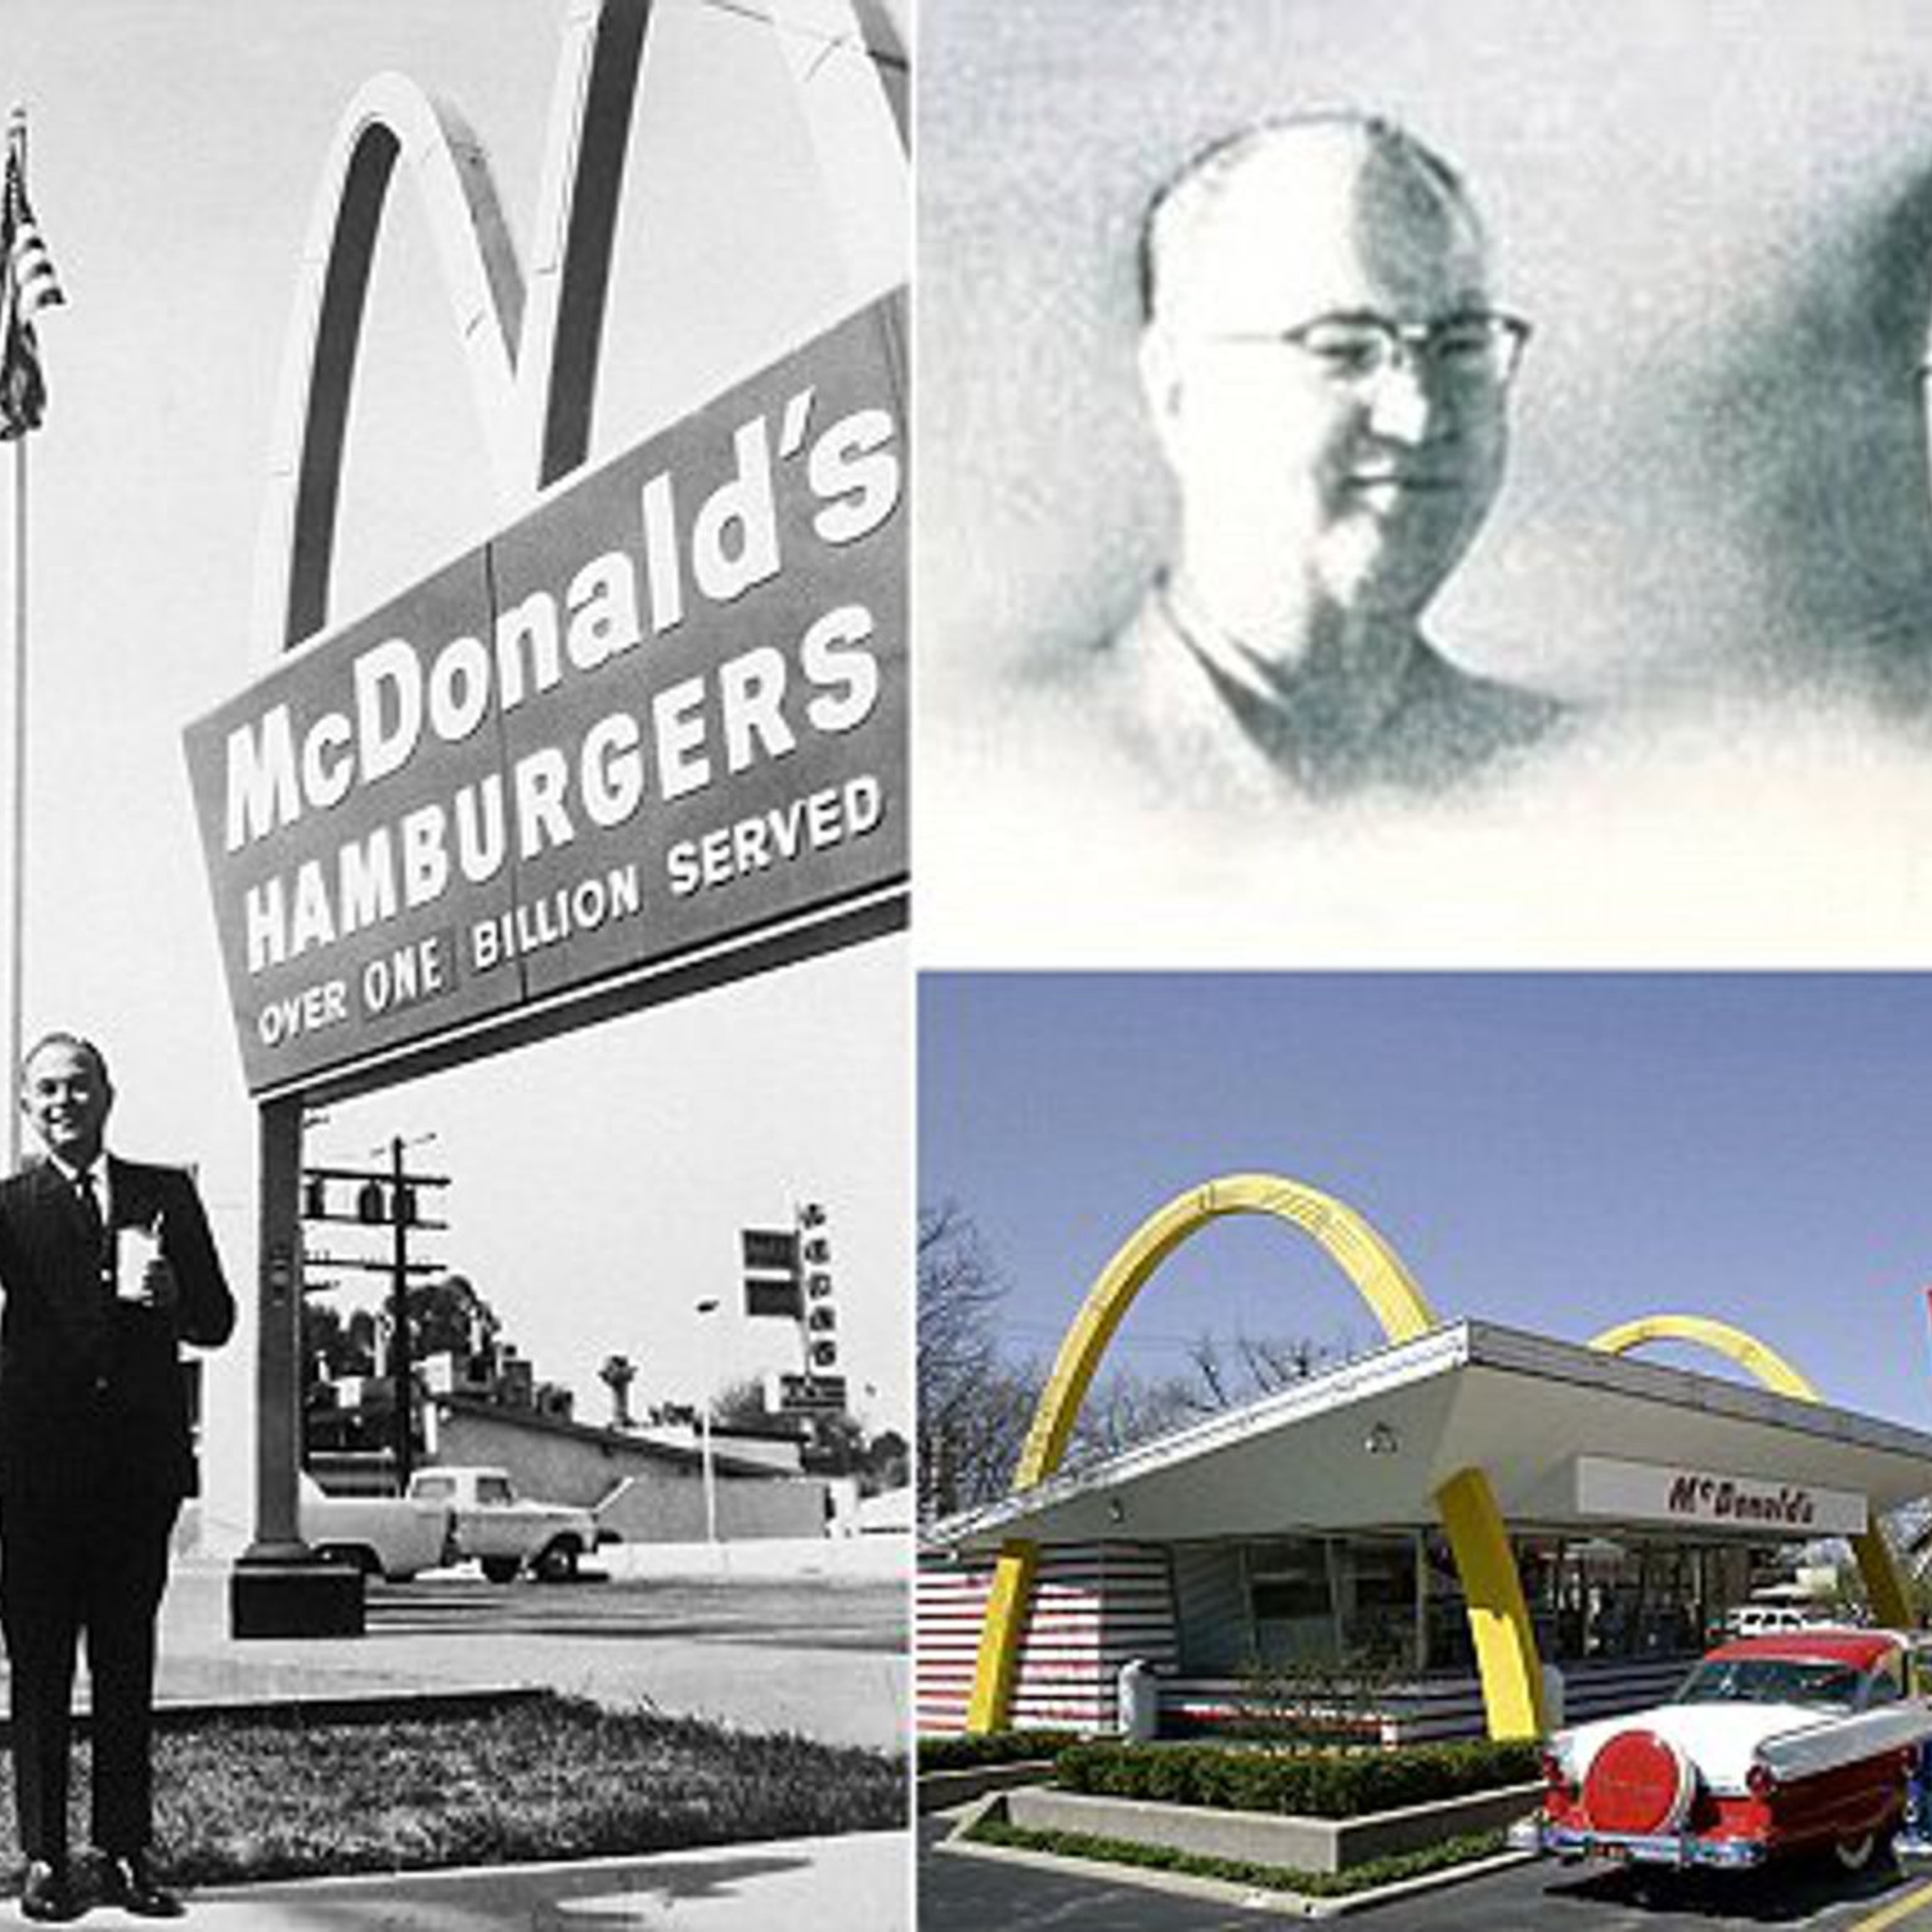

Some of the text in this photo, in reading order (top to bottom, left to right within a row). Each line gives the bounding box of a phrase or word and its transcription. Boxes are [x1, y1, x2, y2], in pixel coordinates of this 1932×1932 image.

[225, 388, 901, 853] McDonald's
[246, 605, 880, 973] HAMBURGERS
[258, 777, 882, 1045] OVER ONE BILLION SERVED
